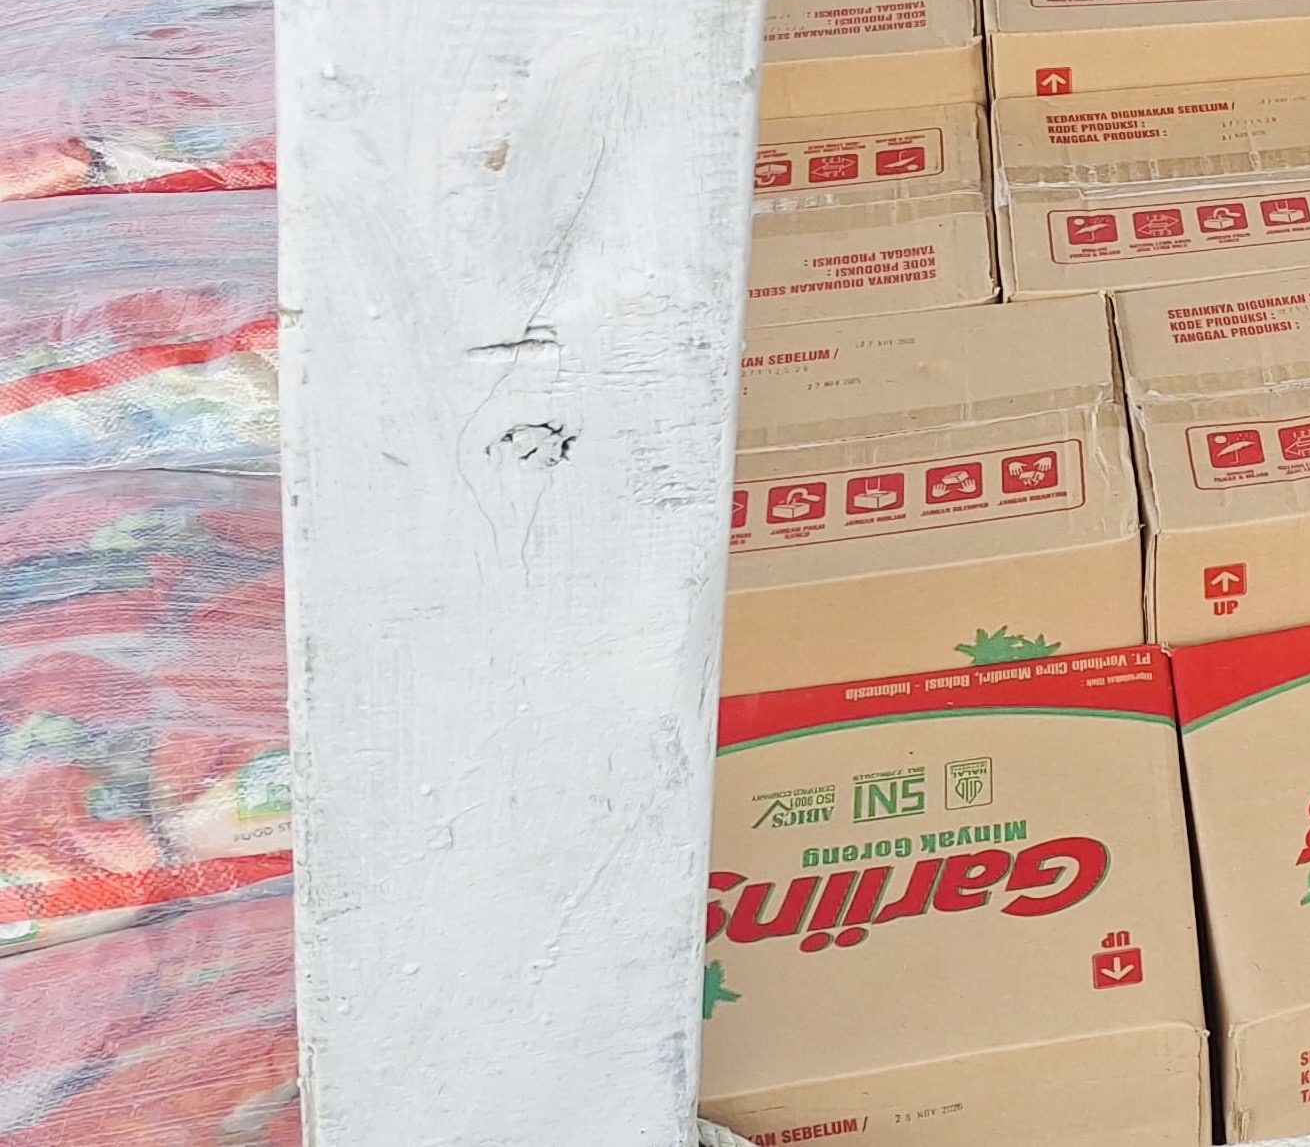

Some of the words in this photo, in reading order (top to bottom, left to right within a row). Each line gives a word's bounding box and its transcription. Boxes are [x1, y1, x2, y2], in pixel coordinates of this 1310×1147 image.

[814, 6, 872, 18] PRODUKSI
[875, 0, 926, 13] TANGGAL
[834, 13, 892, 26] PRODUKSI
[896, 10, 926, 20] KODE
[793, 26, 861, 38] DIGUNAKAN
[864, 19, 926, 32] SEBAIKNYA
[1045, 112, 1108, 124] SEBAIKNYA
[1110, 106, 1175, 119] DIGUNAKAN
[1177, 102, 1229, 114] SEBELUM
[1047, 124, 1077, 133] KODE
[1080, 120, 1138, 133] PRODUKSI
[1048, 133, 1099, 144] TANGGAL
[1102, 128, 1160, 141] PRODUKSI
[812, 252, 876, 267] PRODUKSI
[879, 246, 935, 260] TANGGAL
[835, 261, 899, 277] PRODUKSI
[903, 258, 935, 270] KODE
[790, 277, 864, 293] DIGUNAKAN
[867, 269, 937, 286] SEBAIKNYA
[1167, 303, 1234, 319] SEBAIKNYA
[1236, 293, 1306, 312] DIGUNAKAN
[1169, 319, 1202, 331] KODE
[1205, 311, 1268, 327] PRODUKSI
[1172, 329, 1228, 343] TANGGAL
[1230, 321, 1292, 337] PRODUKSI
[767, 349, 830, 365] SEBELUM
[1213, 599, 1239, 617] UP
[1134, 653, 1151, 665] PT.
[1035, 662, 1068, 675] Citra
[845, 681, 910, 701] Indonesia
[816, 793, 836, 805] ISO
[853, 776, 926, 820] SNI
[771, 806, 835, 829] ABICS
[919, 820, 1028, 850] Minyak
[802, 842, 911, 868] Goreng
[1102, 930, 1131, 948] UP
[781, 1118, 858, 1143] SEBELUM
